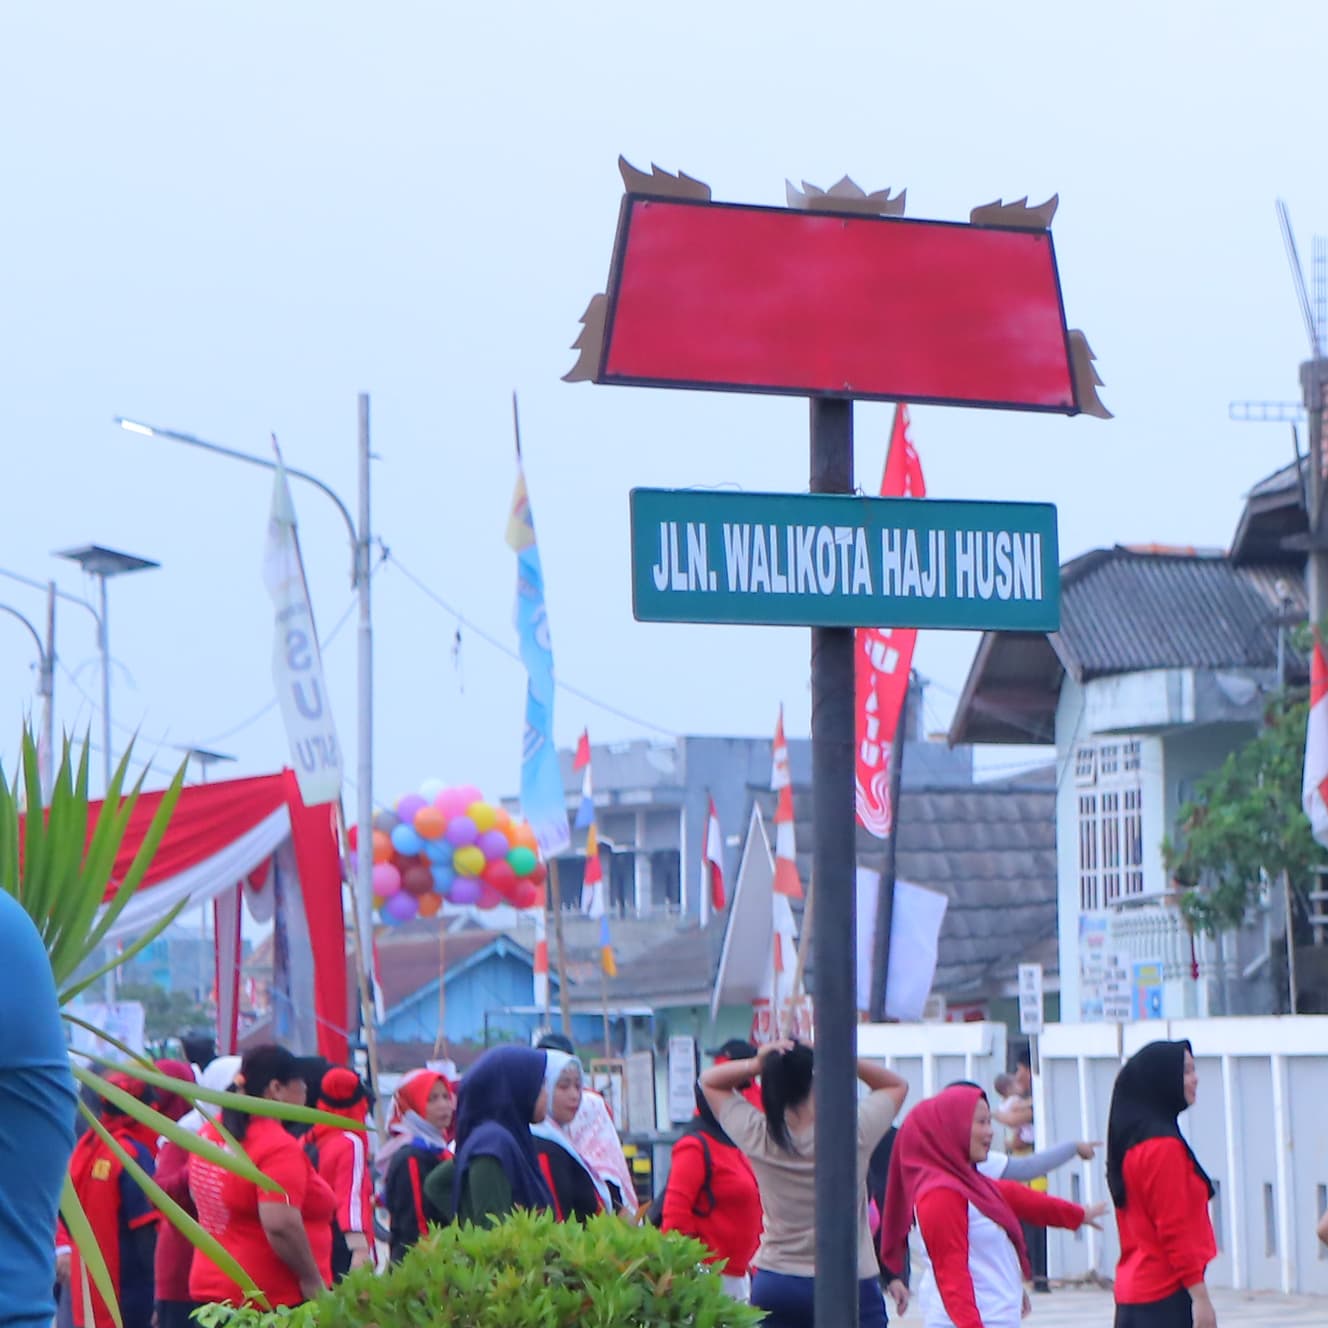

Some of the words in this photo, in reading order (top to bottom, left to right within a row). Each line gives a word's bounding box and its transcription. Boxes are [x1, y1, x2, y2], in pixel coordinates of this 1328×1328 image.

[653, 522, 717, 592] JLN.
[723, 524, 873, 596] WALIKOTA
[882, 528, 946, 598] HAJI
[955, 530, 1043, 600] HUSNI
